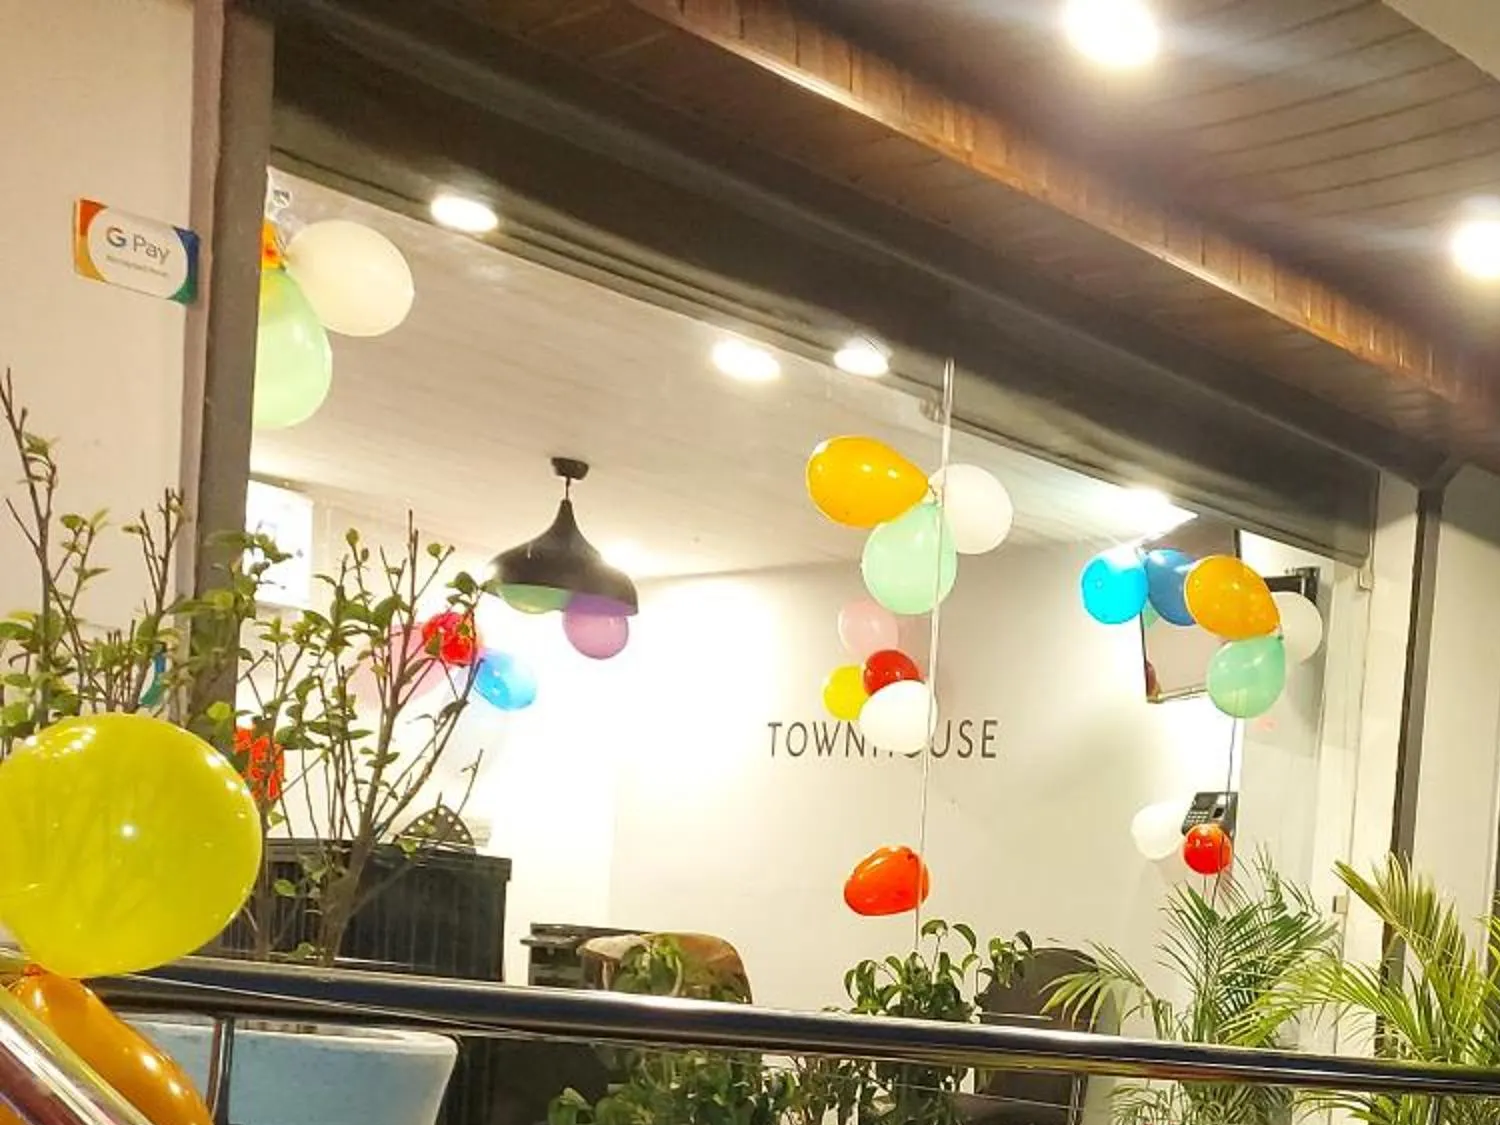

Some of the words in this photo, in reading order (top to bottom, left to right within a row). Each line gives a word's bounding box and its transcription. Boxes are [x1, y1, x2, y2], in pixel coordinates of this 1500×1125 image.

[105, 225, 127, 248] G
[132, 233, 171, 265] Pay
[767, 719, 998, 759] TOWNUSE
